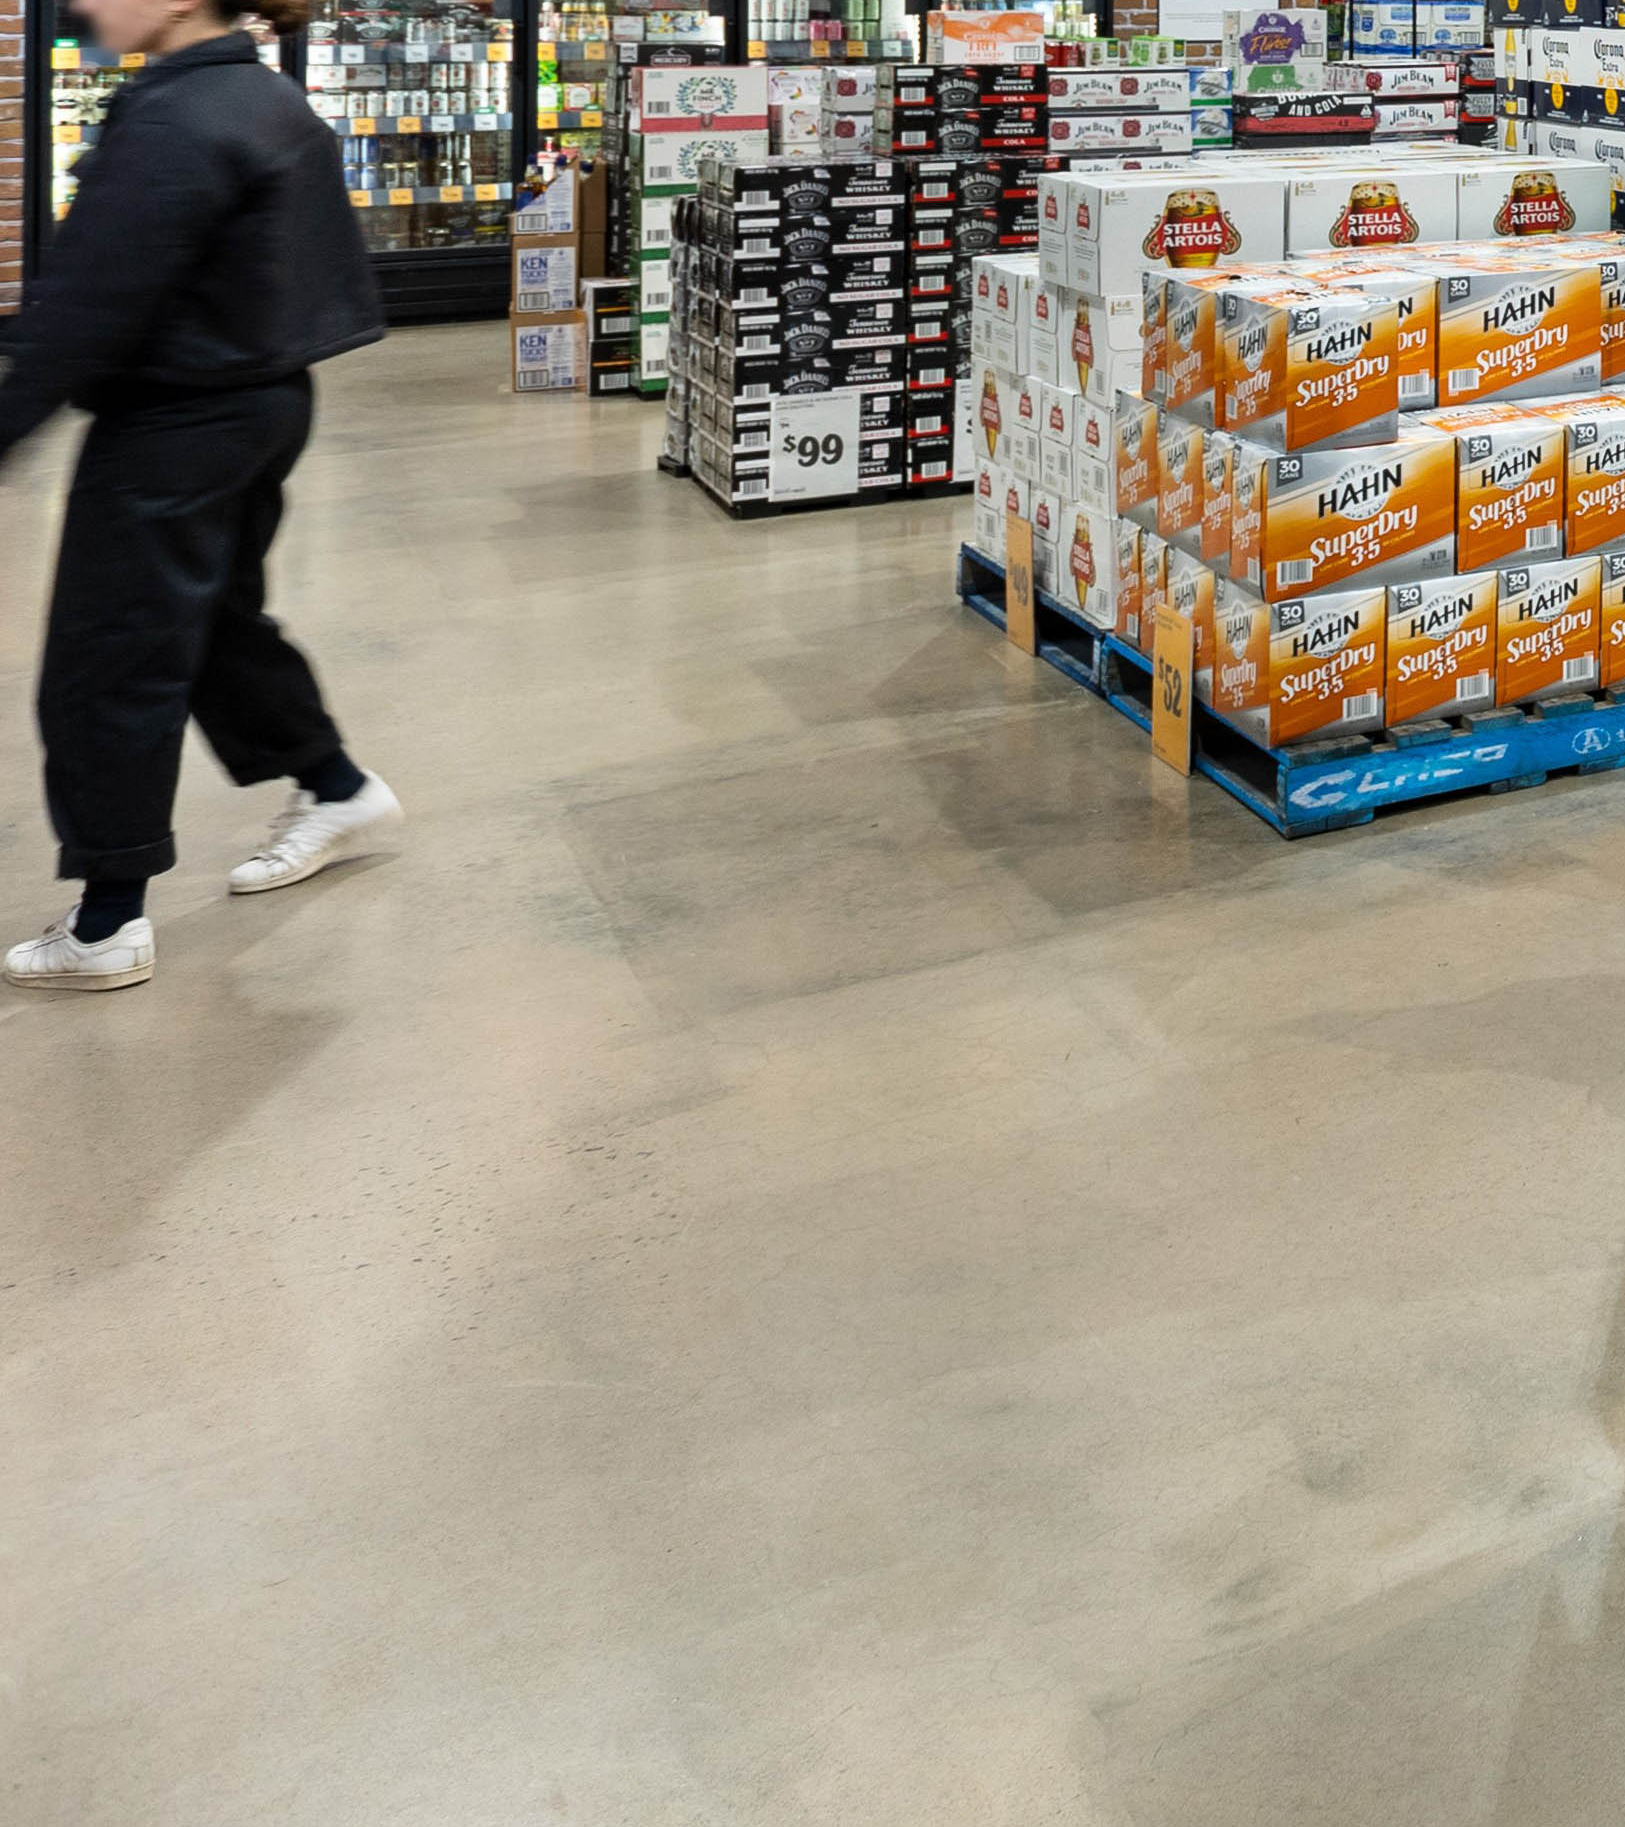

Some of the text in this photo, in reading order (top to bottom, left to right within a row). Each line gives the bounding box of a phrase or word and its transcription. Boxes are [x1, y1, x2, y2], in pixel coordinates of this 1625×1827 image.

[995, 83, 1034, 91] WHISKEY
[1289, 95, 1342, 116] AND COLA
[1163, 222, 1221, 235] STELLA
[1163, 234, 1222, 247] ARTOIS
[1450, 280, 1467, 290] 30
[1483, 286, 1555, 331] HAHN
[1477, 324, 1568, 373] SuperDry
[783, 434, 843, 467] $99
[1159, 655, 1182, 717] $52
